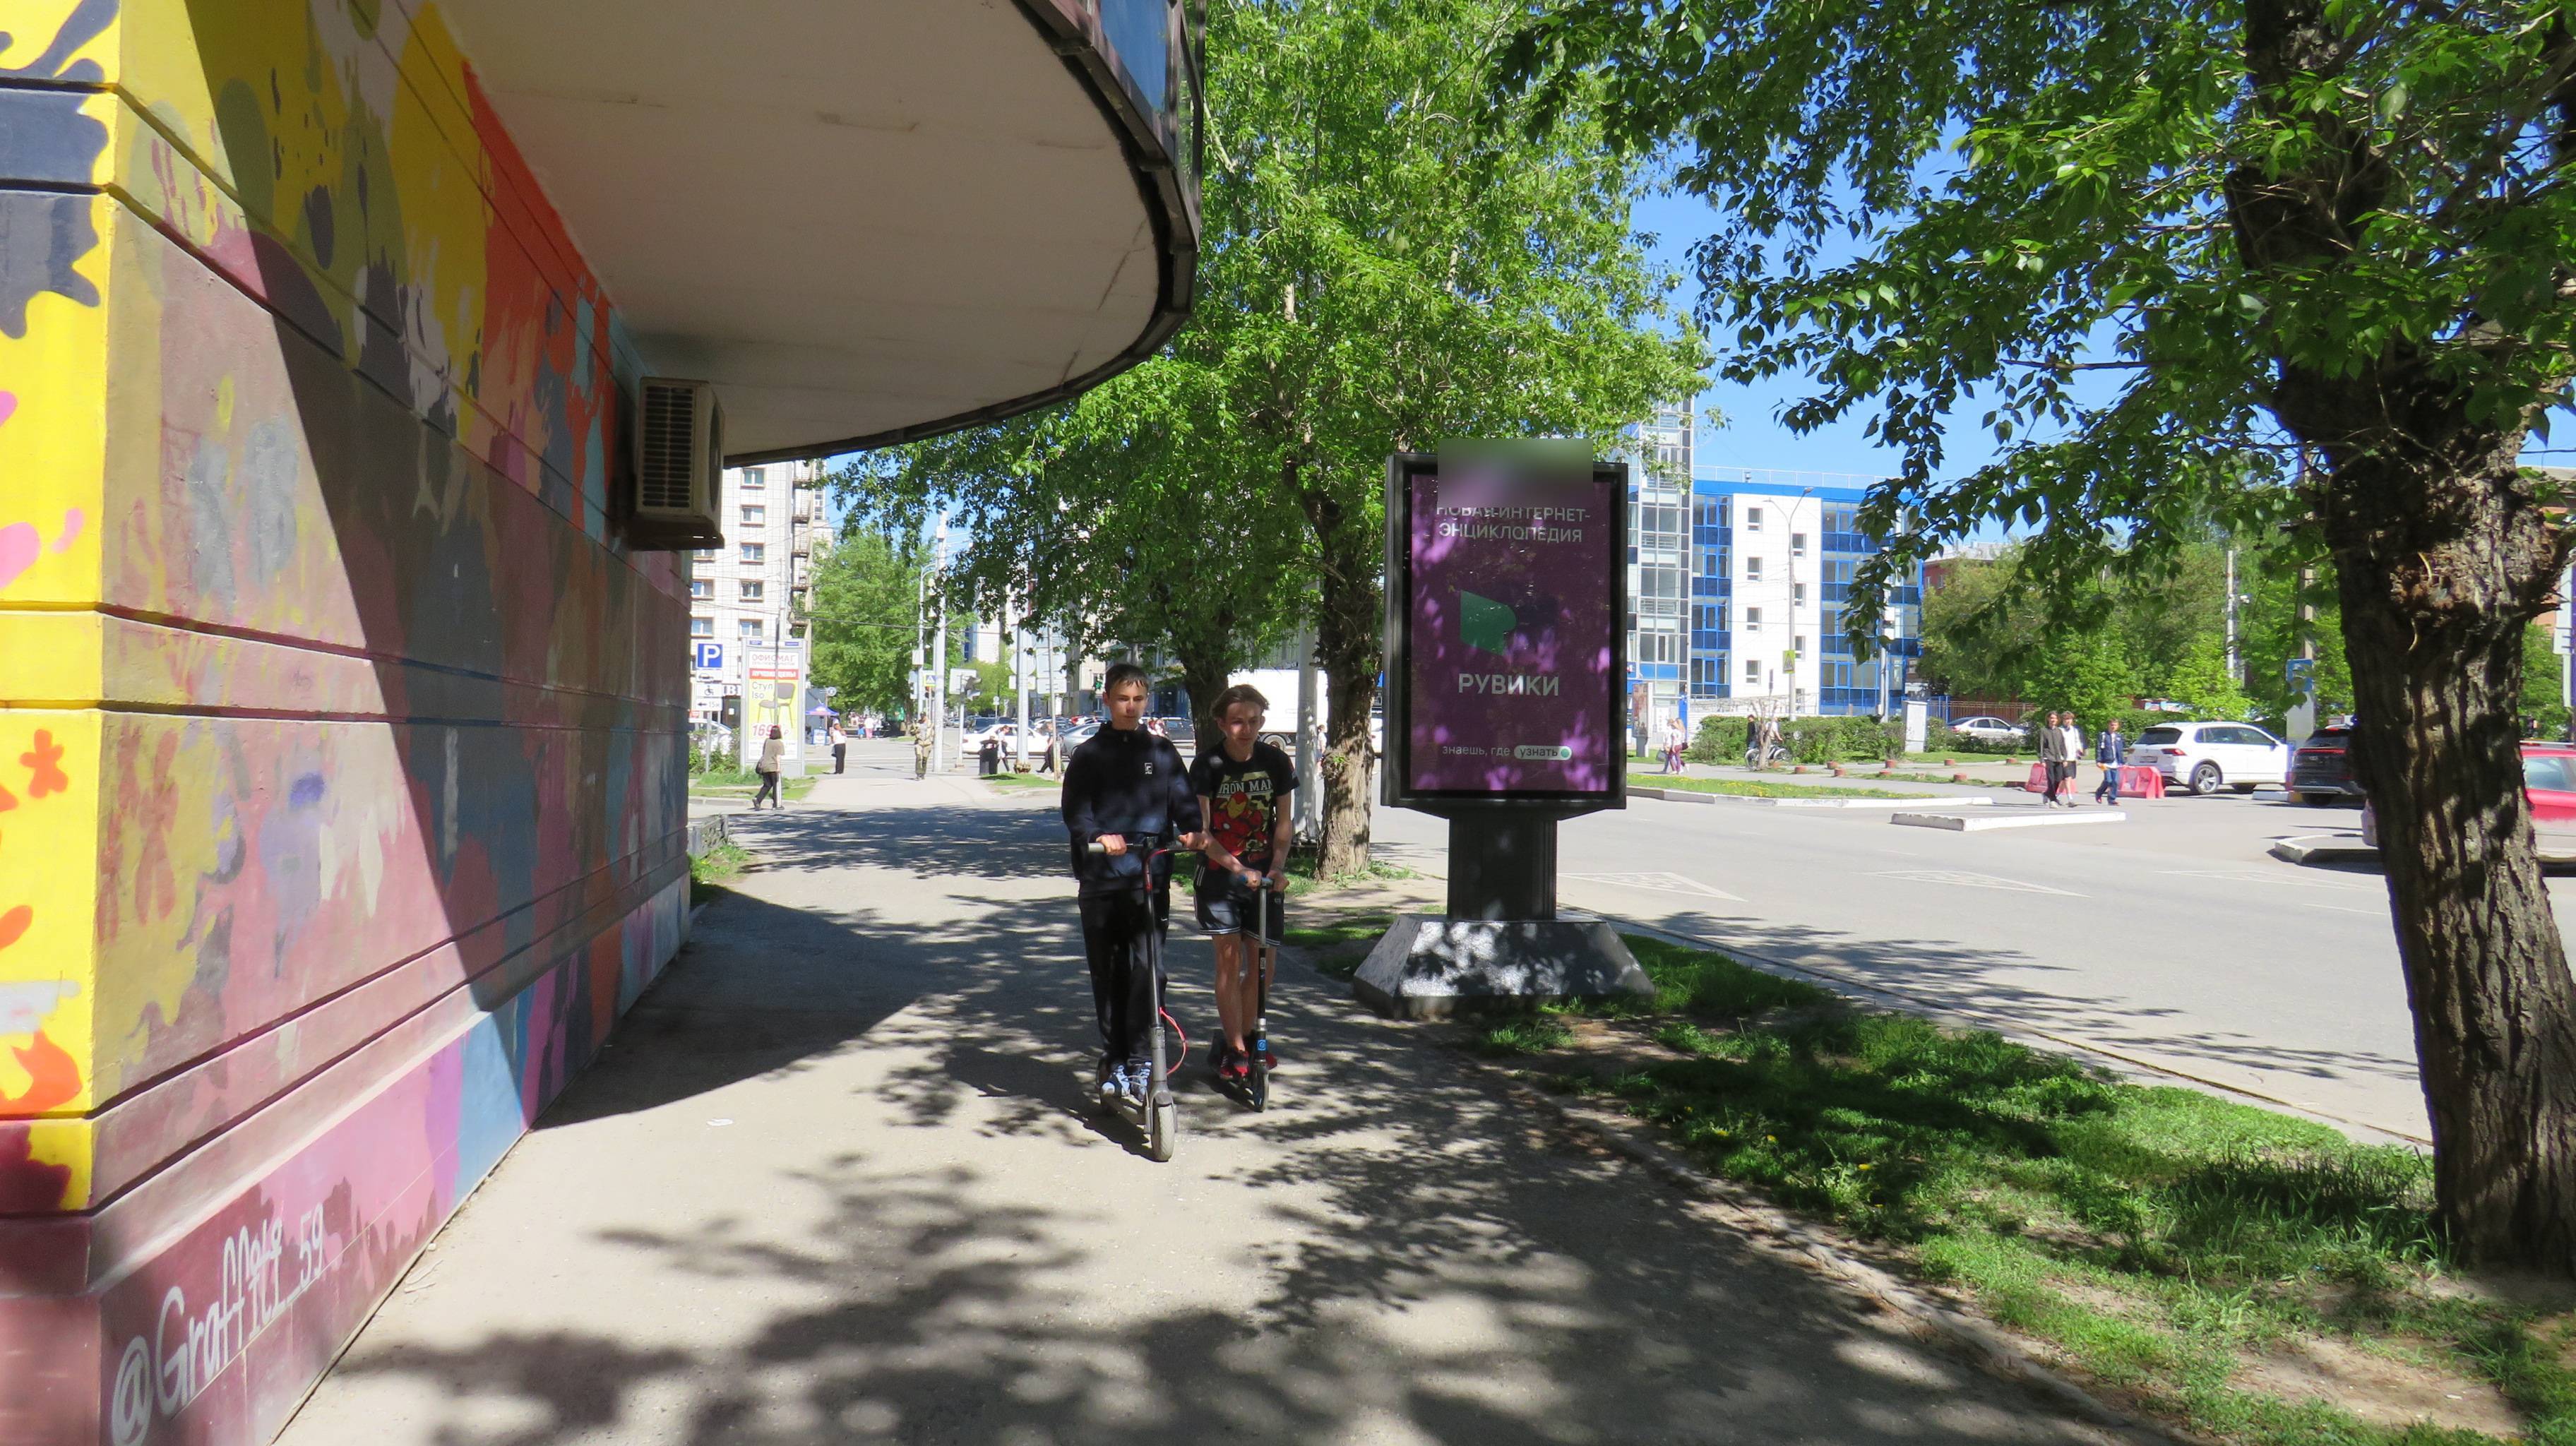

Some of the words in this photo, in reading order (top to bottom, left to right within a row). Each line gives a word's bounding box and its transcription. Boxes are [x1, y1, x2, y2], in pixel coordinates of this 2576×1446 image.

[1438, 522, 1582, 543] ЭНЦИКЛОПЕДИЯ
[703, 645, 720, 667] P
[752, 681, 773, 690] Стул
[1458, 673, 1559, 696] РУВИКИ
[1442, 746, 1488, 757] знаешь,
[1491, 747, 1511, 757] где
[1520, 747, 1558, 758] узнать
[1219, 782, 1244, 794] IRON
